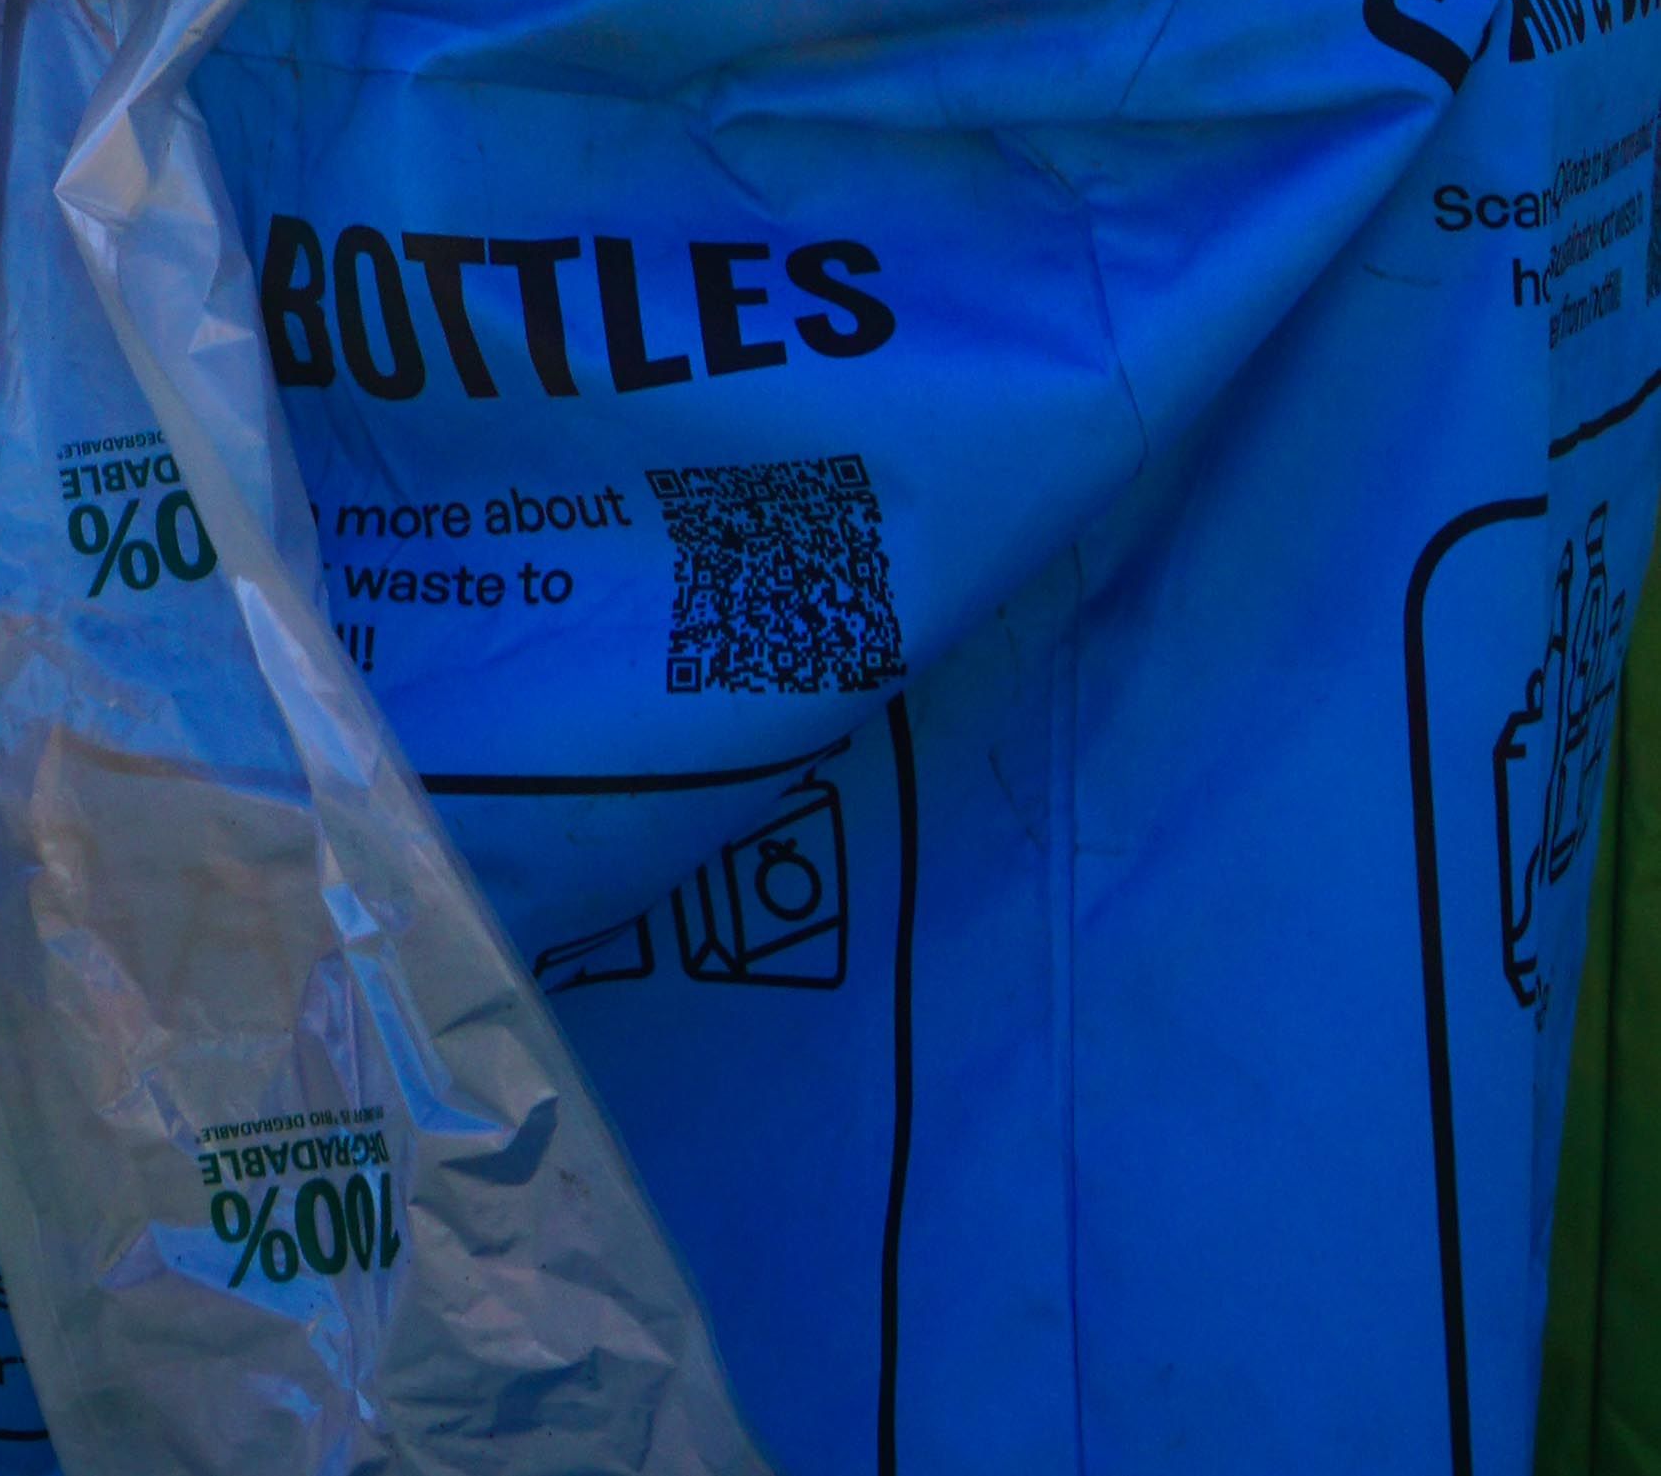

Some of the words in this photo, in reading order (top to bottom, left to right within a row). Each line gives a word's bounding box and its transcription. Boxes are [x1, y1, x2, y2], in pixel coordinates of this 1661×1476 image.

[261, 214, 896, 401] BOTTLES
[337, 501, 471, 539] more
[485, 476, 632, 537] about
[343, 561, 506, 608] waste
[518, 561, 574, 604] to
[198, 1129, 391, 1186] DEGRADABLE
[211, 1173, 401, 1290] 100%
